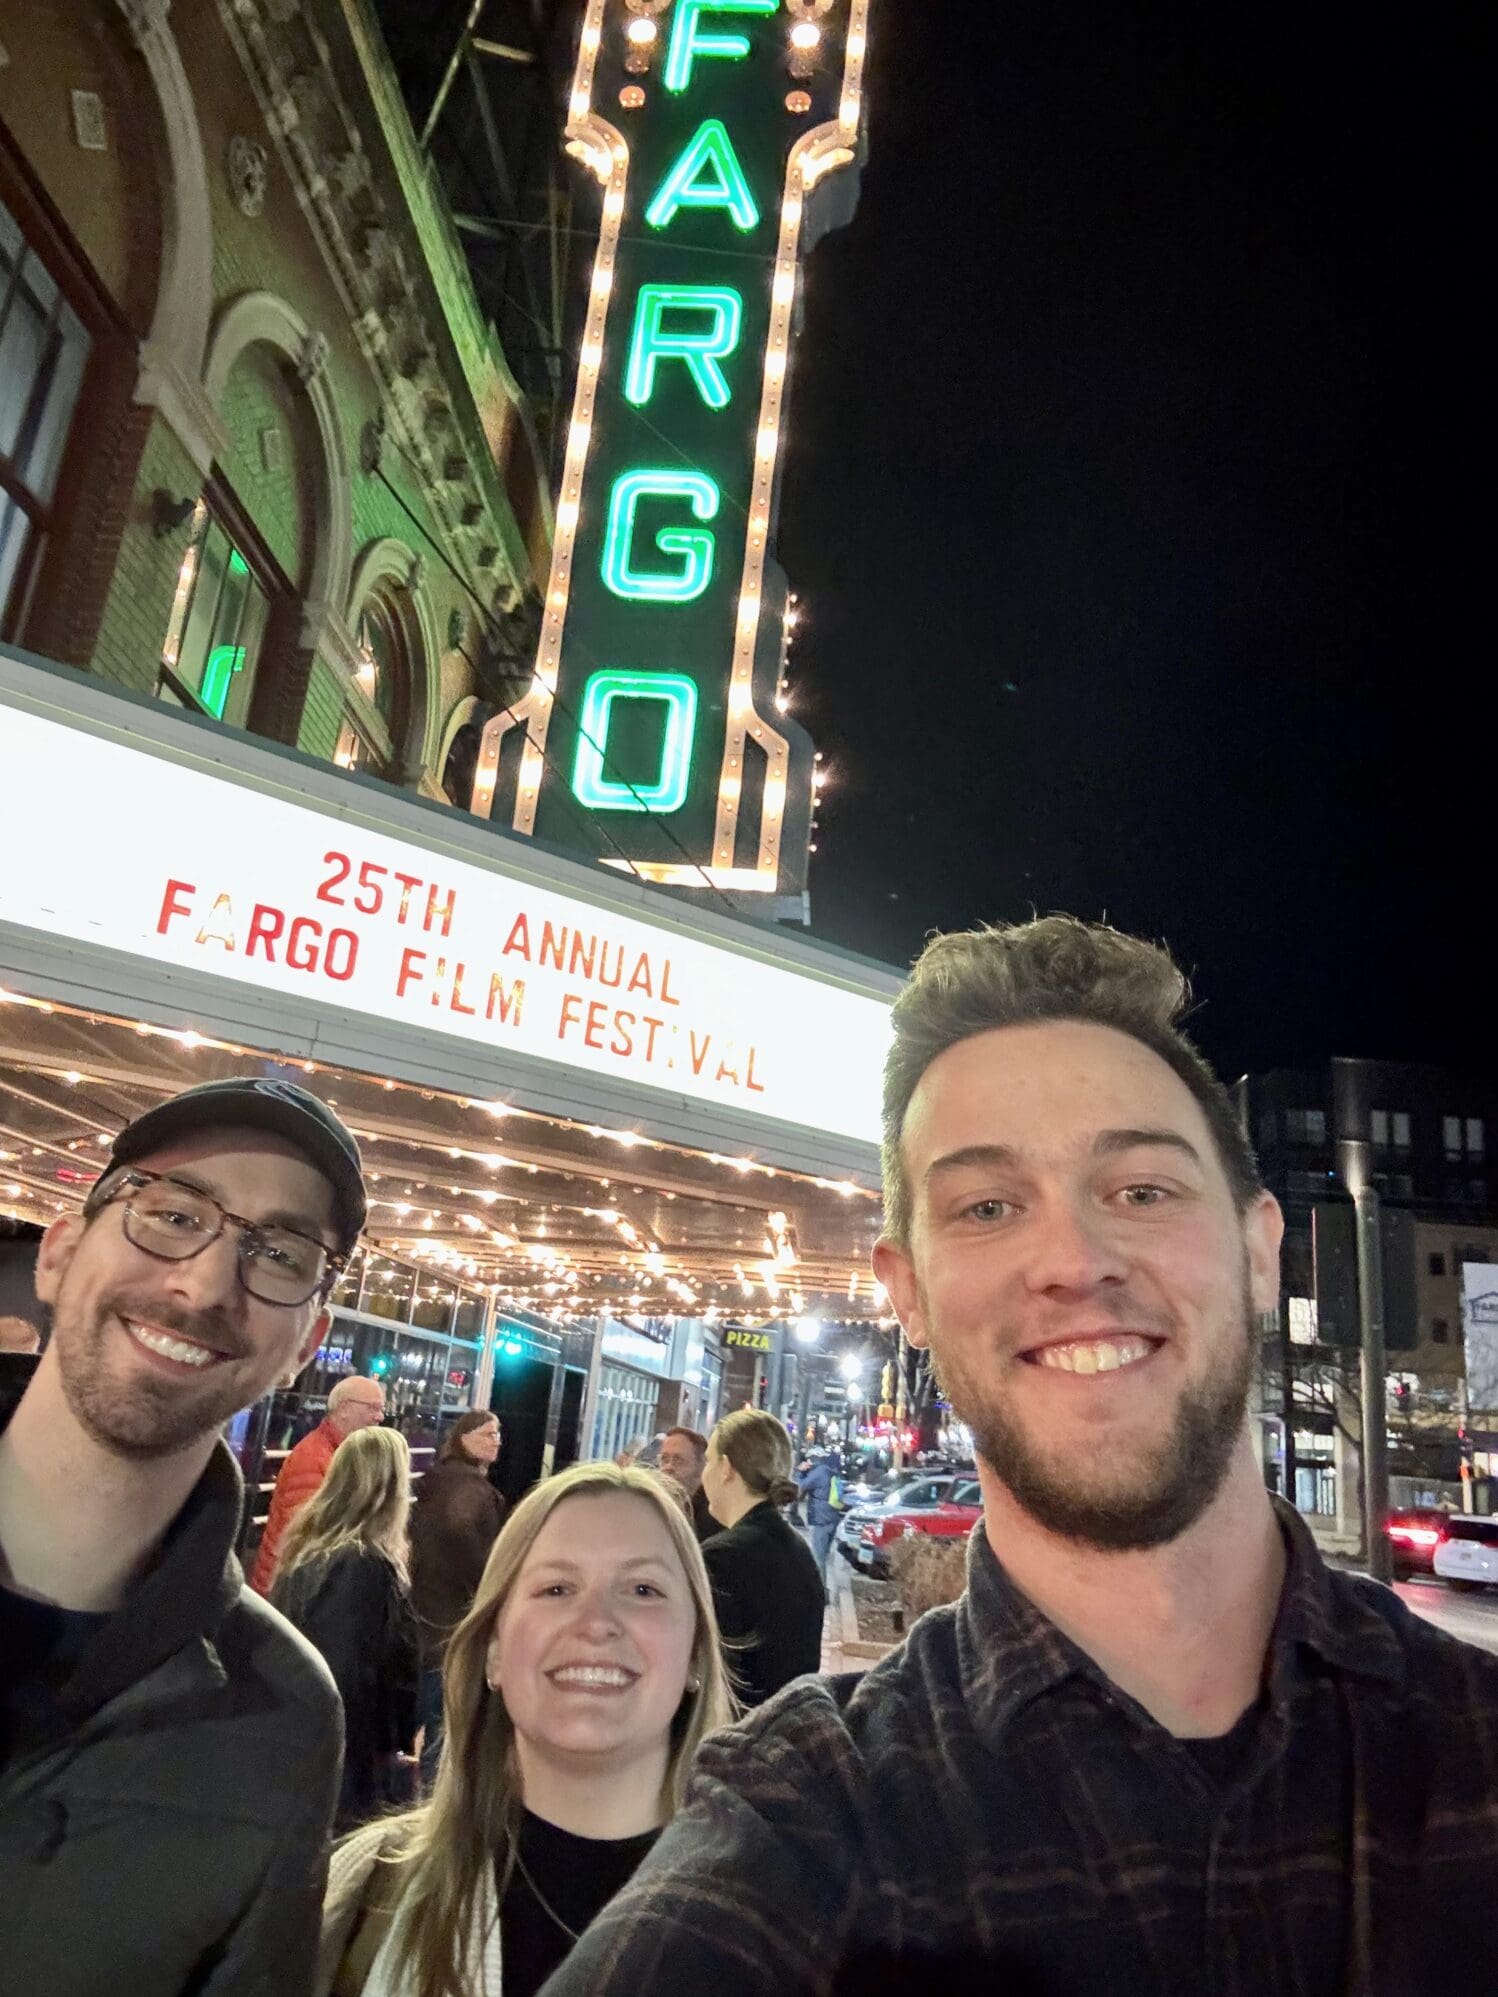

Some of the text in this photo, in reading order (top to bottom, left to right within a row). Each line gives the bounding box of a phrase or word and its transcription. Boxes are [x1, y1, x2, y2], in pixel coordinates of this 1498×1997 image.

[573, 0, 780, 814] FARGO
[156, 878, 360, 981] FARGO
[395, 947, 526, 1027] FILM
[316, 851, 680, 1006] 25TH ANNUAL
[725, 1330, 770, 1349] PIZZA
